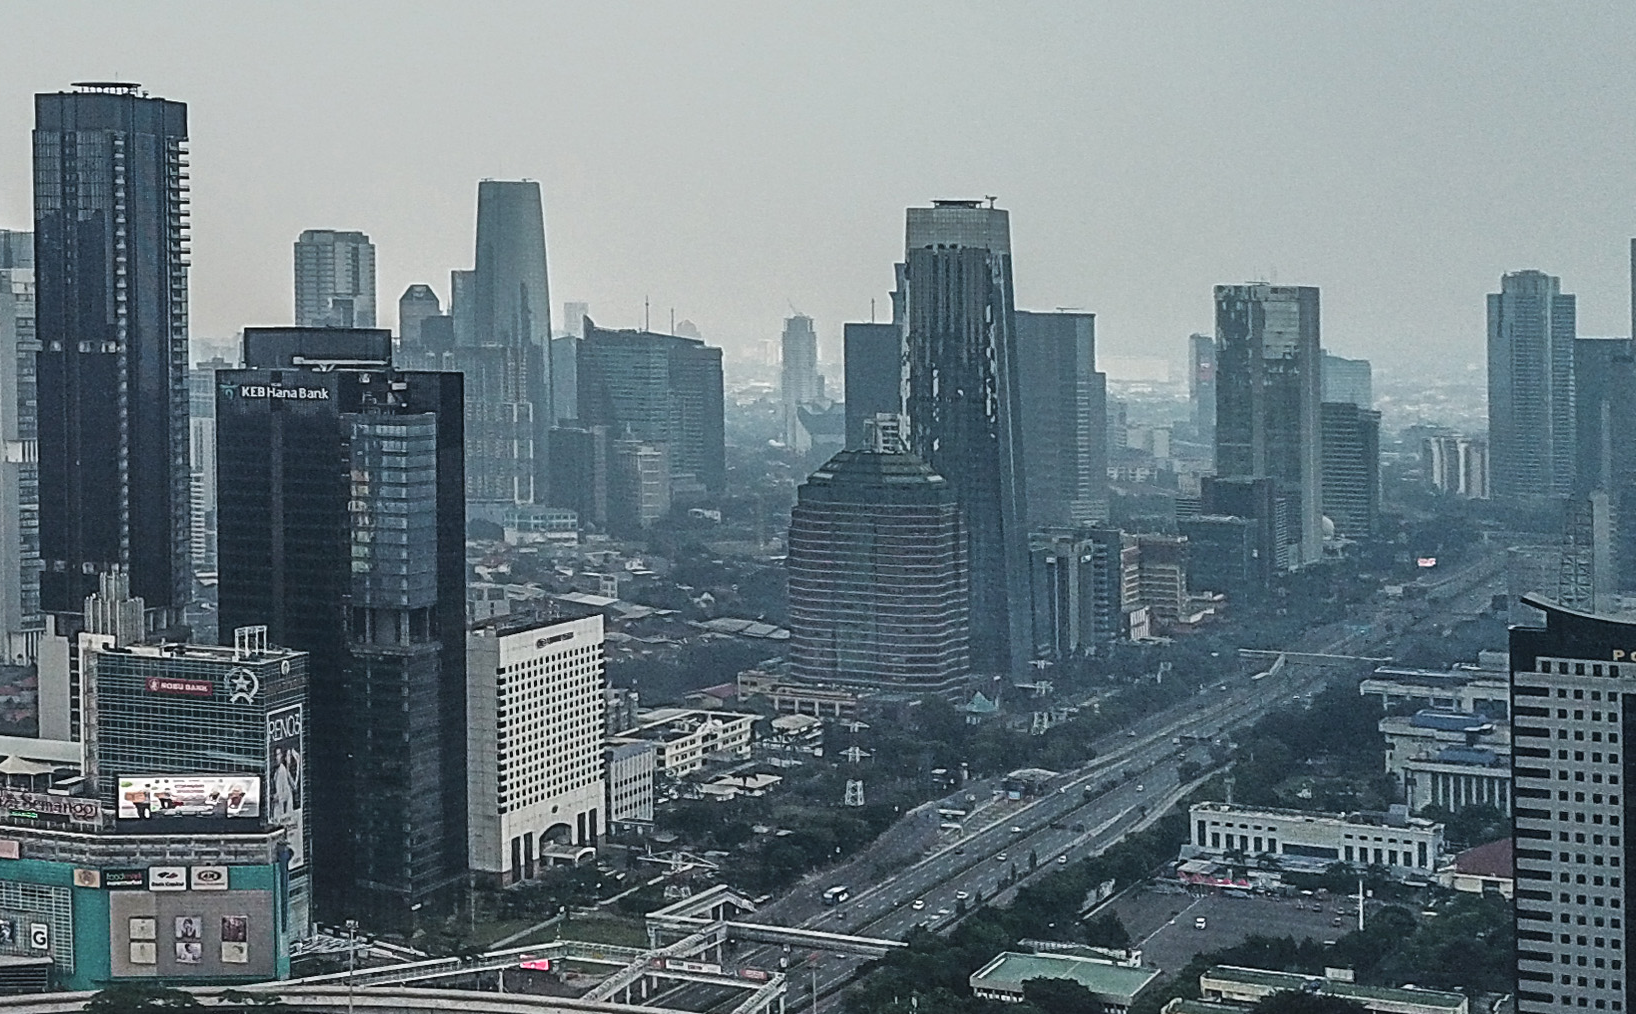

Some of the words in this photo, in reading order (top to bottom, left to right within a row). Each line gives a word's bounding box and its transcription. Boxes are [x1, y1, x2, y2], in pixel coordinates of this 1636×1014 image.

[241, 386, 266, 398] KEB
[266, 386, 298, 399] Hana
[298, 387, 329, 400] Bank
[32, 930, 47, 946] G
